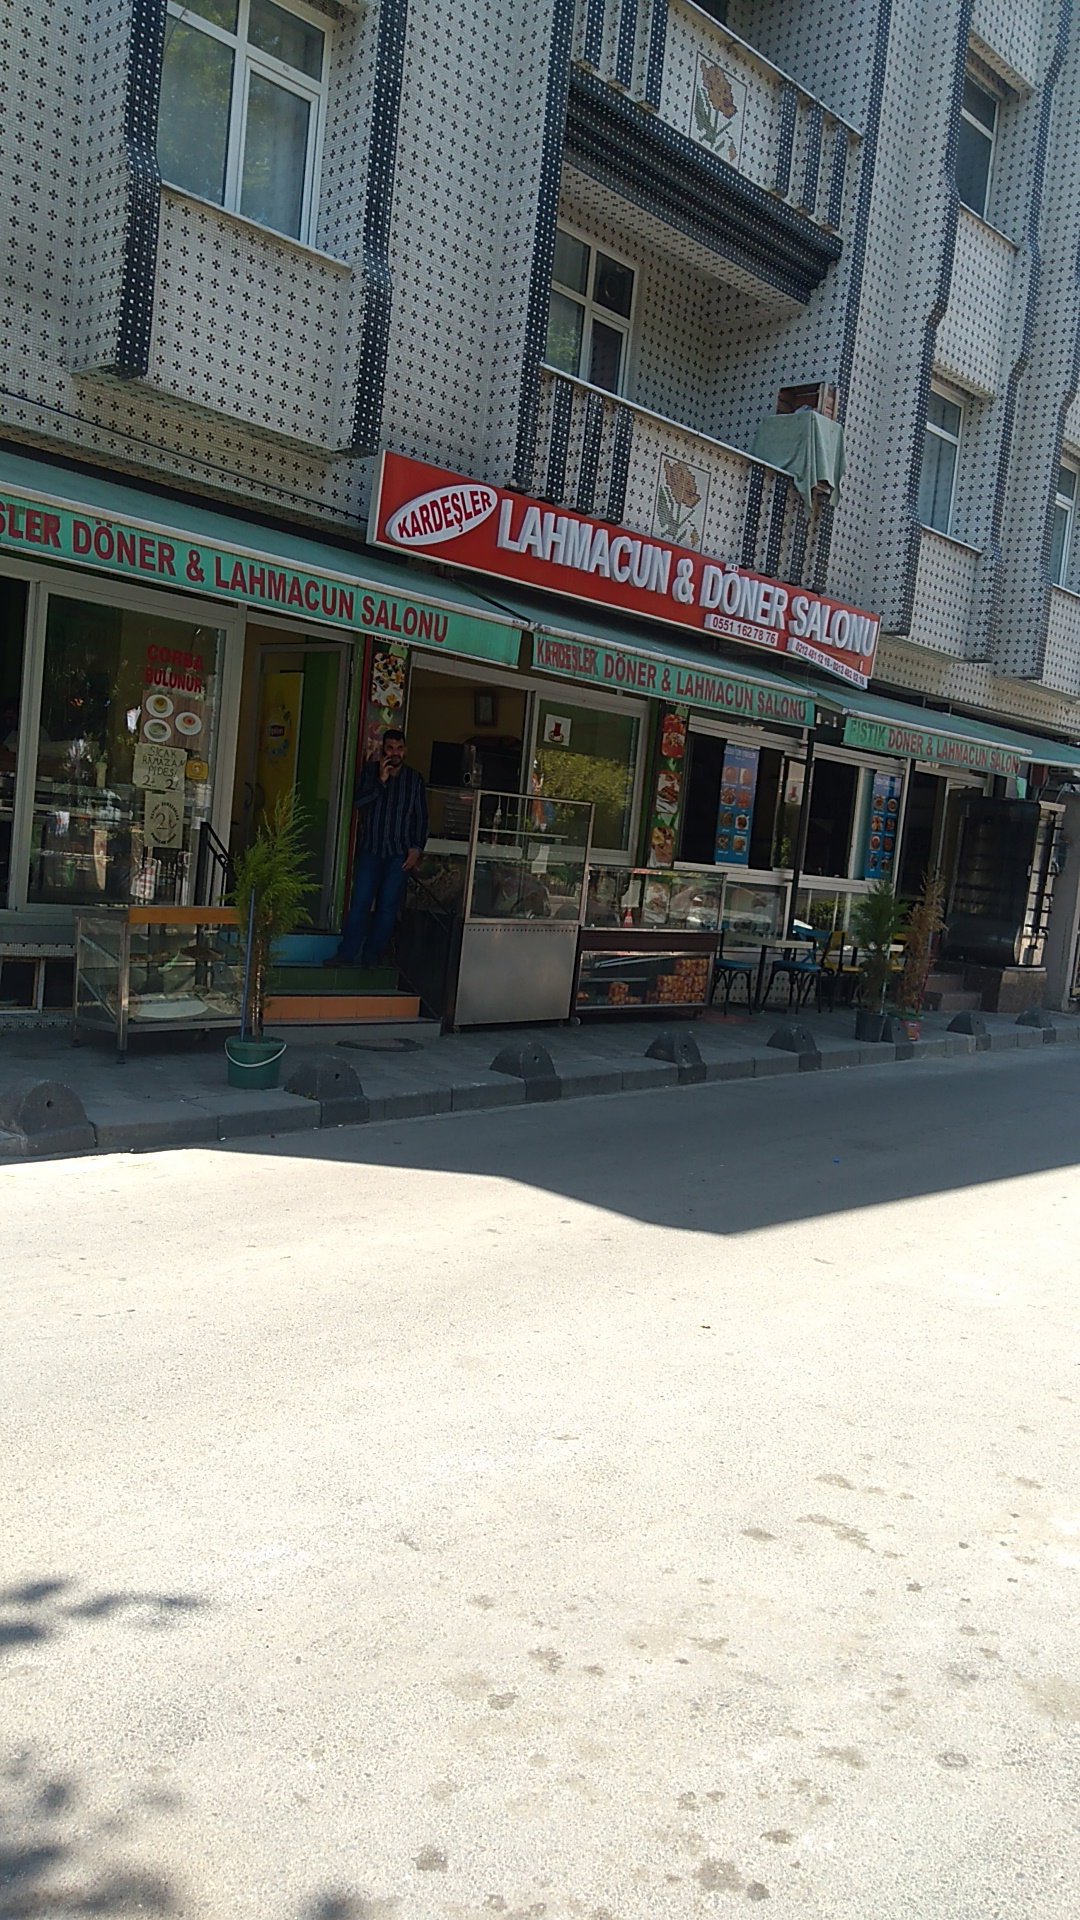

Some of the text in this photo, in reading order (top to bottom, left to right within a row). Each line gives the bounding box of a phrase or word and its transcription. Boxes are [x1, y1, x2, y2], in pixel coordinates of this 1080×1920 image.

[397, 490, 493, 539] KARDEŞLER
[72, 519, 176, 577] DÖNER
[186, 549, 205, 583] &
[215, 555, 354, 621] LAHMACUN
[361, 595, 448, 643] SALONU
[497, 498, 878, 658] LAHMACUN & DÖNER SALONU
[712, 615, 776, 645] 0551 162 78 76
[144, 666, 203, 693] BULUNUR
[603, 652, 656, 689] DÖNER
[661, 667, 671, 692] &
[675, 670, 753, 711] LAHMACUN
[757, 690, 807, 721] SALONU
[888, 727, 923, 755] DÖNER
[926, 737, 933, 756] &
[936, 738, 987, 767] LAHMACUN
